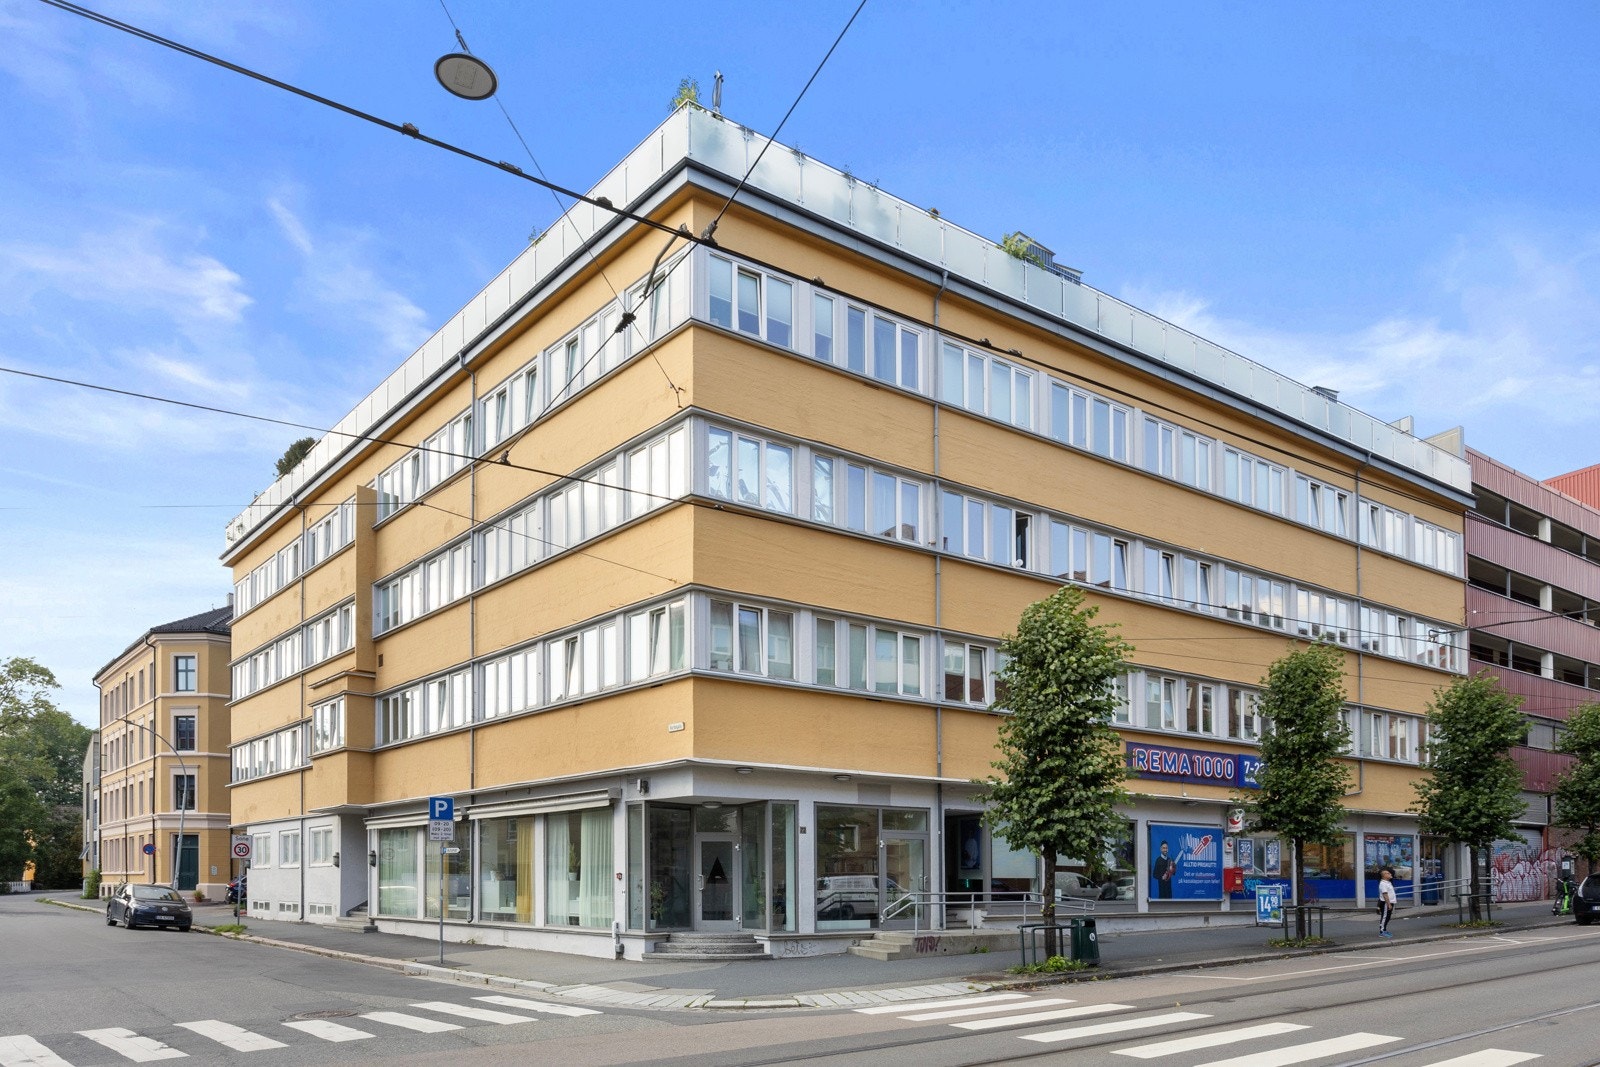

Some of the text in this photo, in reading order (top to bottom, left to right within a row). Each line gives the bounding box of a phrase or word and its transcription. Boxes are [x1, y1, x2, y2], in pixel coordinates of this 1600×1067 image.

[1133, 748, 1235, 779] REMA 1000
[435, 800, 448, 817] P
[237, 846, 247, 854] 30
[1259, 896, 1271, 912] 14
